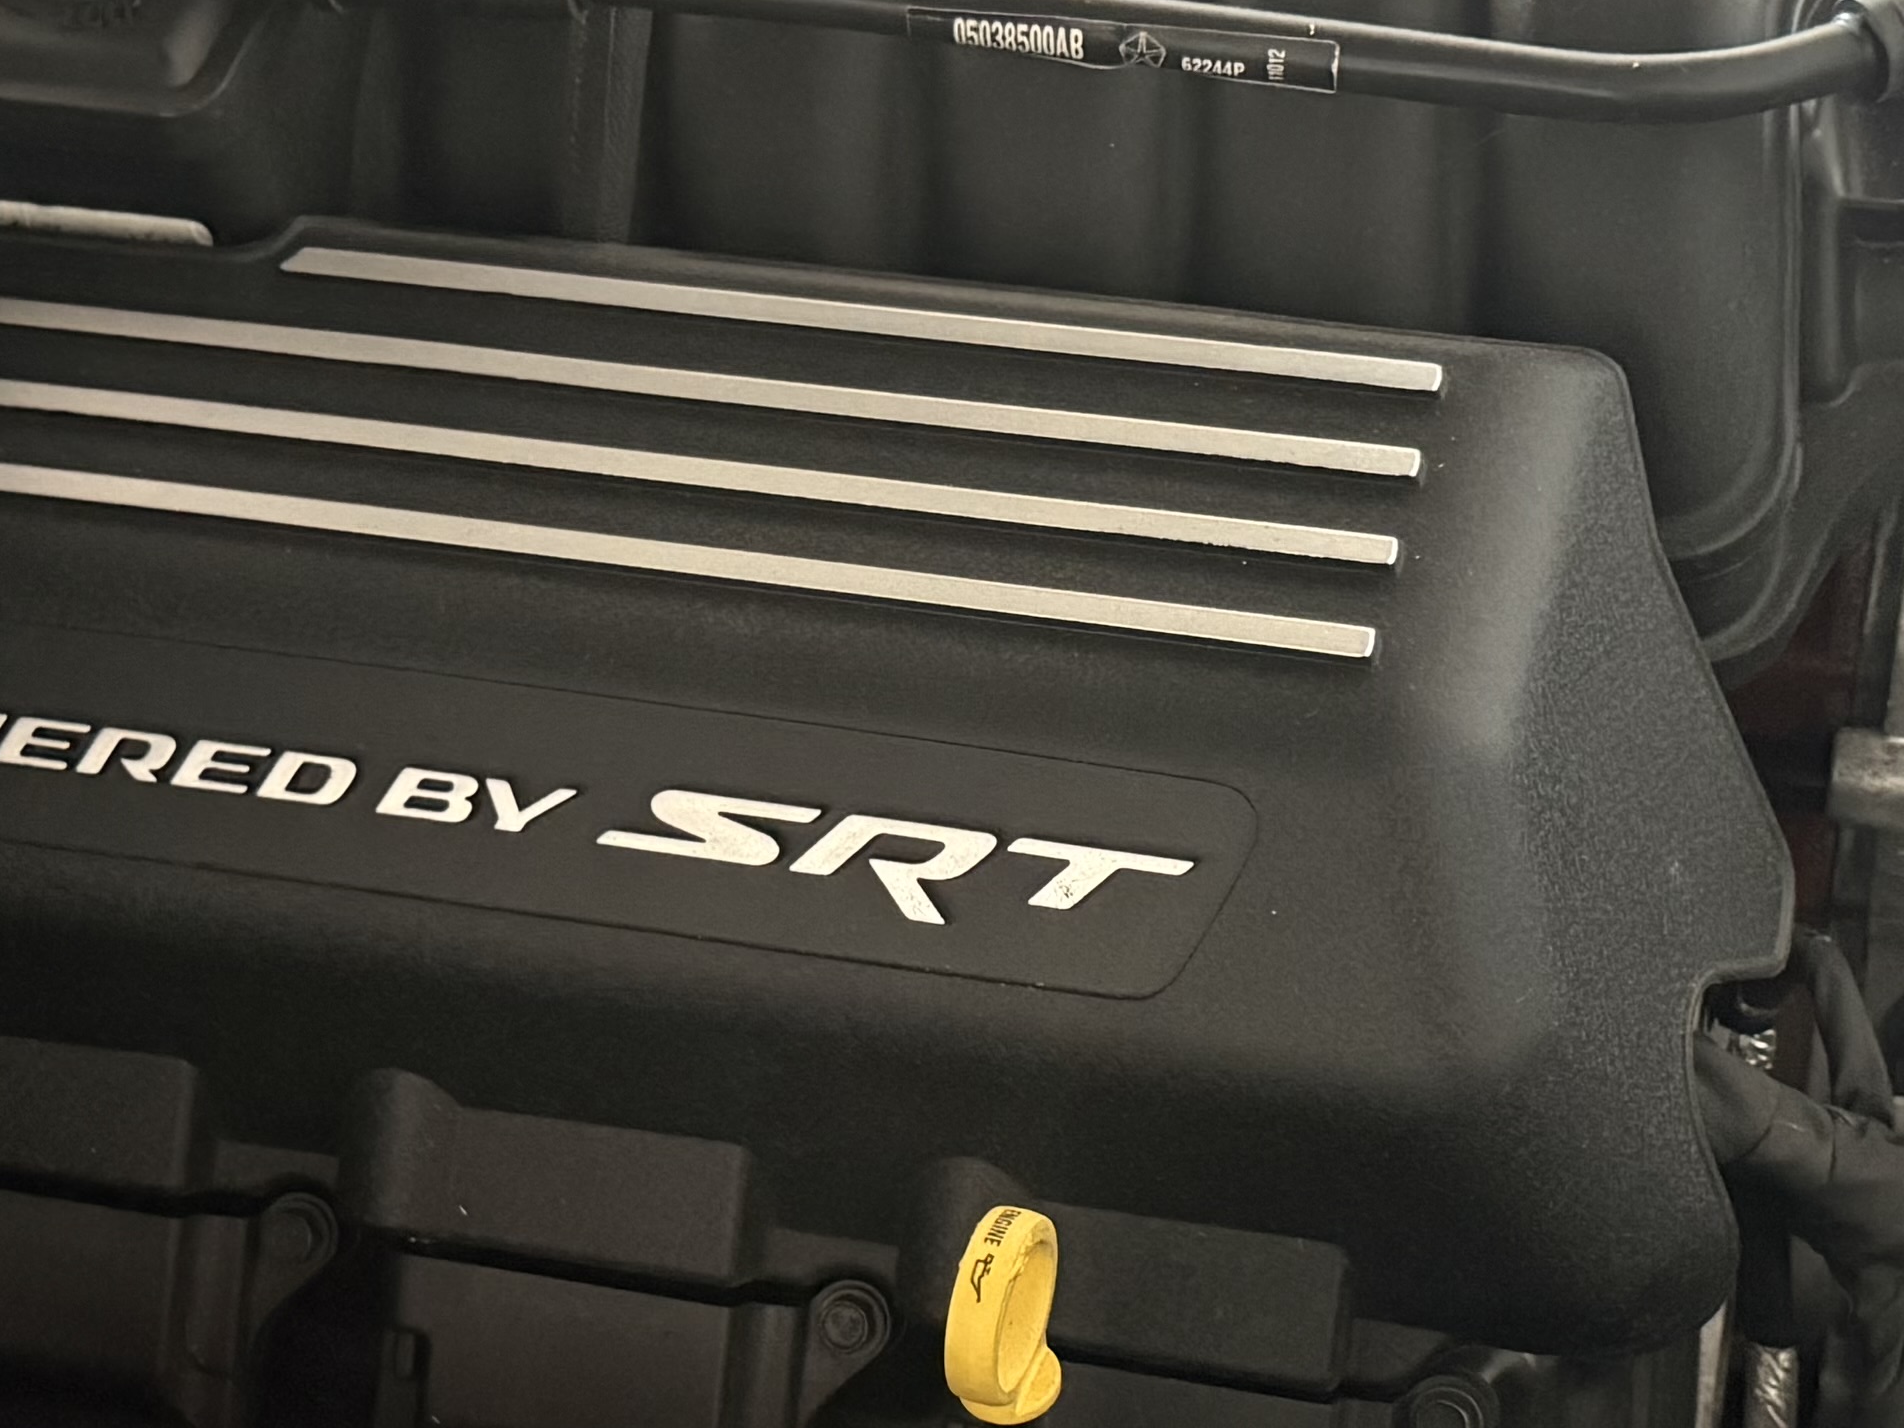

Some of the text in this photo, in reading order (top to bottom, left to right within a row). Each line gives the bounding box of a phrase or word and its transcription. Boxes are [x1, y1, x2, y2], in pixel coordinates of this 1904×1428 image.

[953, 17, 1084, 59] 05038500AB
[1181, 56, 1246, 77] 62244P
[374, 766, 578, 832] BY
[595, 787, 1196, 926] SRT
[984, 1209, 1022, 1247] ENGINE
